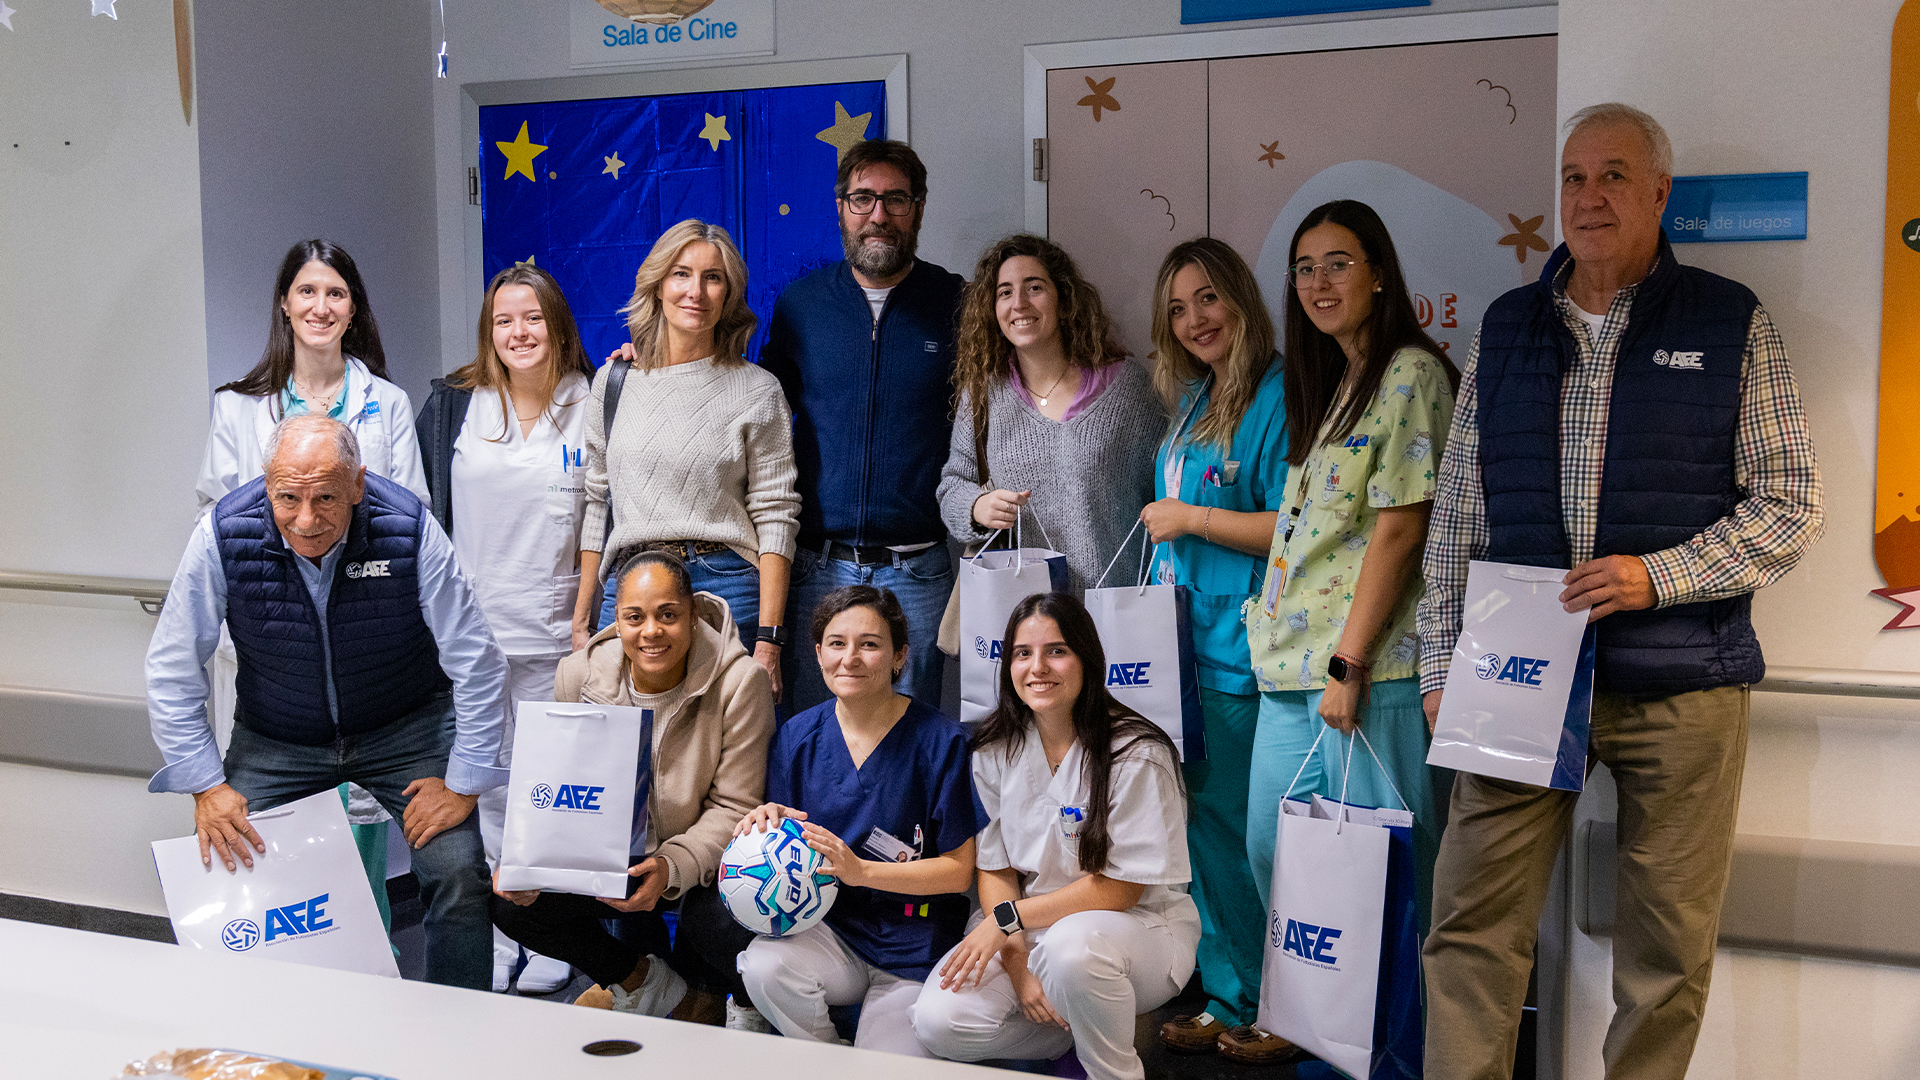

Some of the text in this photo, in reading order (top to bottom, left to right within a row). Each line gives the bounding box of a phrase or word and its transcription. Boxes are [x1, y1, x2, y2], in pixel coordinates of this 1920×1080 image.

[603, 18, 738, 47] Sala de Cine
[1673, 215, 1792, 232] Sala de juegos
[1414, 292, 1458, 329] DE
[1669, 351, 1704, 367] AFE
[361, 560, 391, 578] AFE
[1107, 661, 1151, 686] AFE
[1497, 655, 1550, 686] AFE
[553, 784, 605, 811] AFE
[785, 844, 803, 905] EVO
[264, 892, 333, 943] AFE
[1283, 918, 1343, 965] AFE
